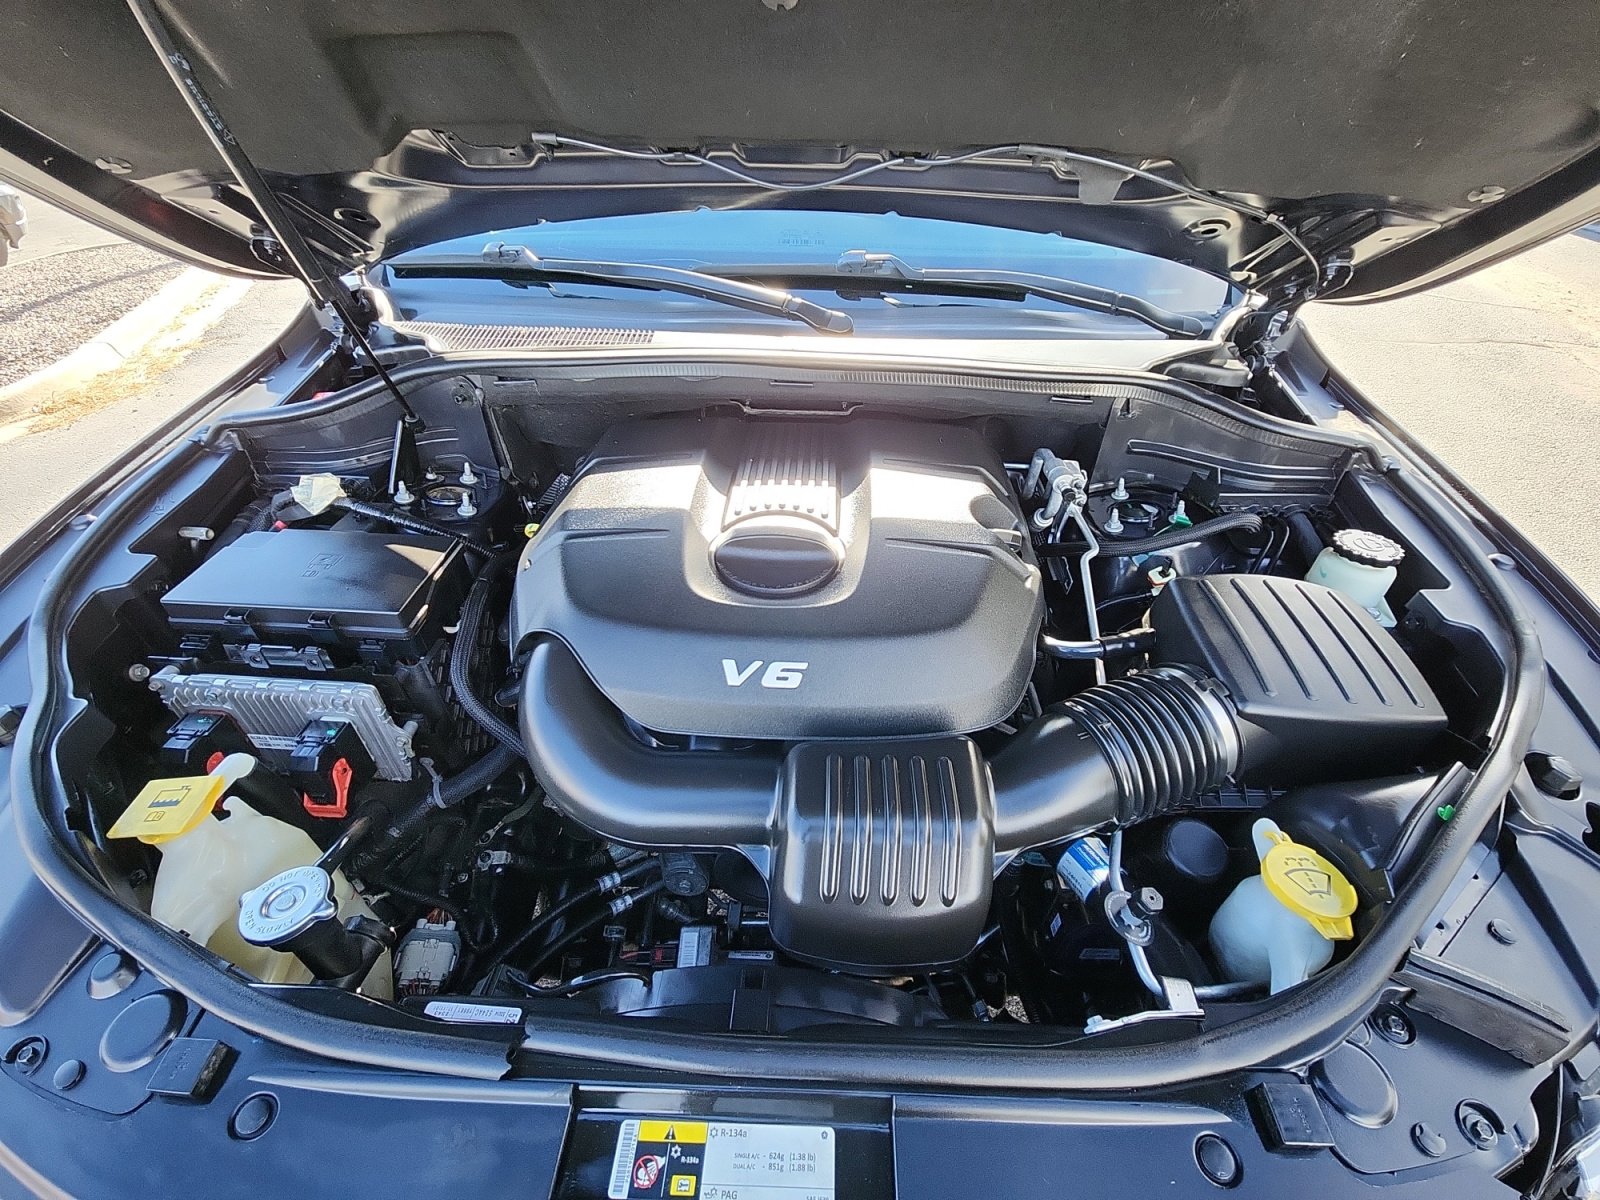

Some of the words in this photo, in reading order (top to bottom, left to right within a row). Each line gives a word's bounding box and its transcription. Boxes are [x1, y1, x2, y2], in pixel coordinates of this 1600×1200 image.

[722, 659, 809, 689] V6
[720, 1128, 748, 1138] R-134a
[768, 1152, 785, 1162] 624g
[789, 1152, 806, 1162] (1.38
[807, 1152, 816, 1162] lb)
[768, 1163, 784, 1172] 851g
[788, 1163, 806, 1173] (1.88
[807, 1163, 816, 1173] lb)
[721, 1190, 738, 1200] PAG
